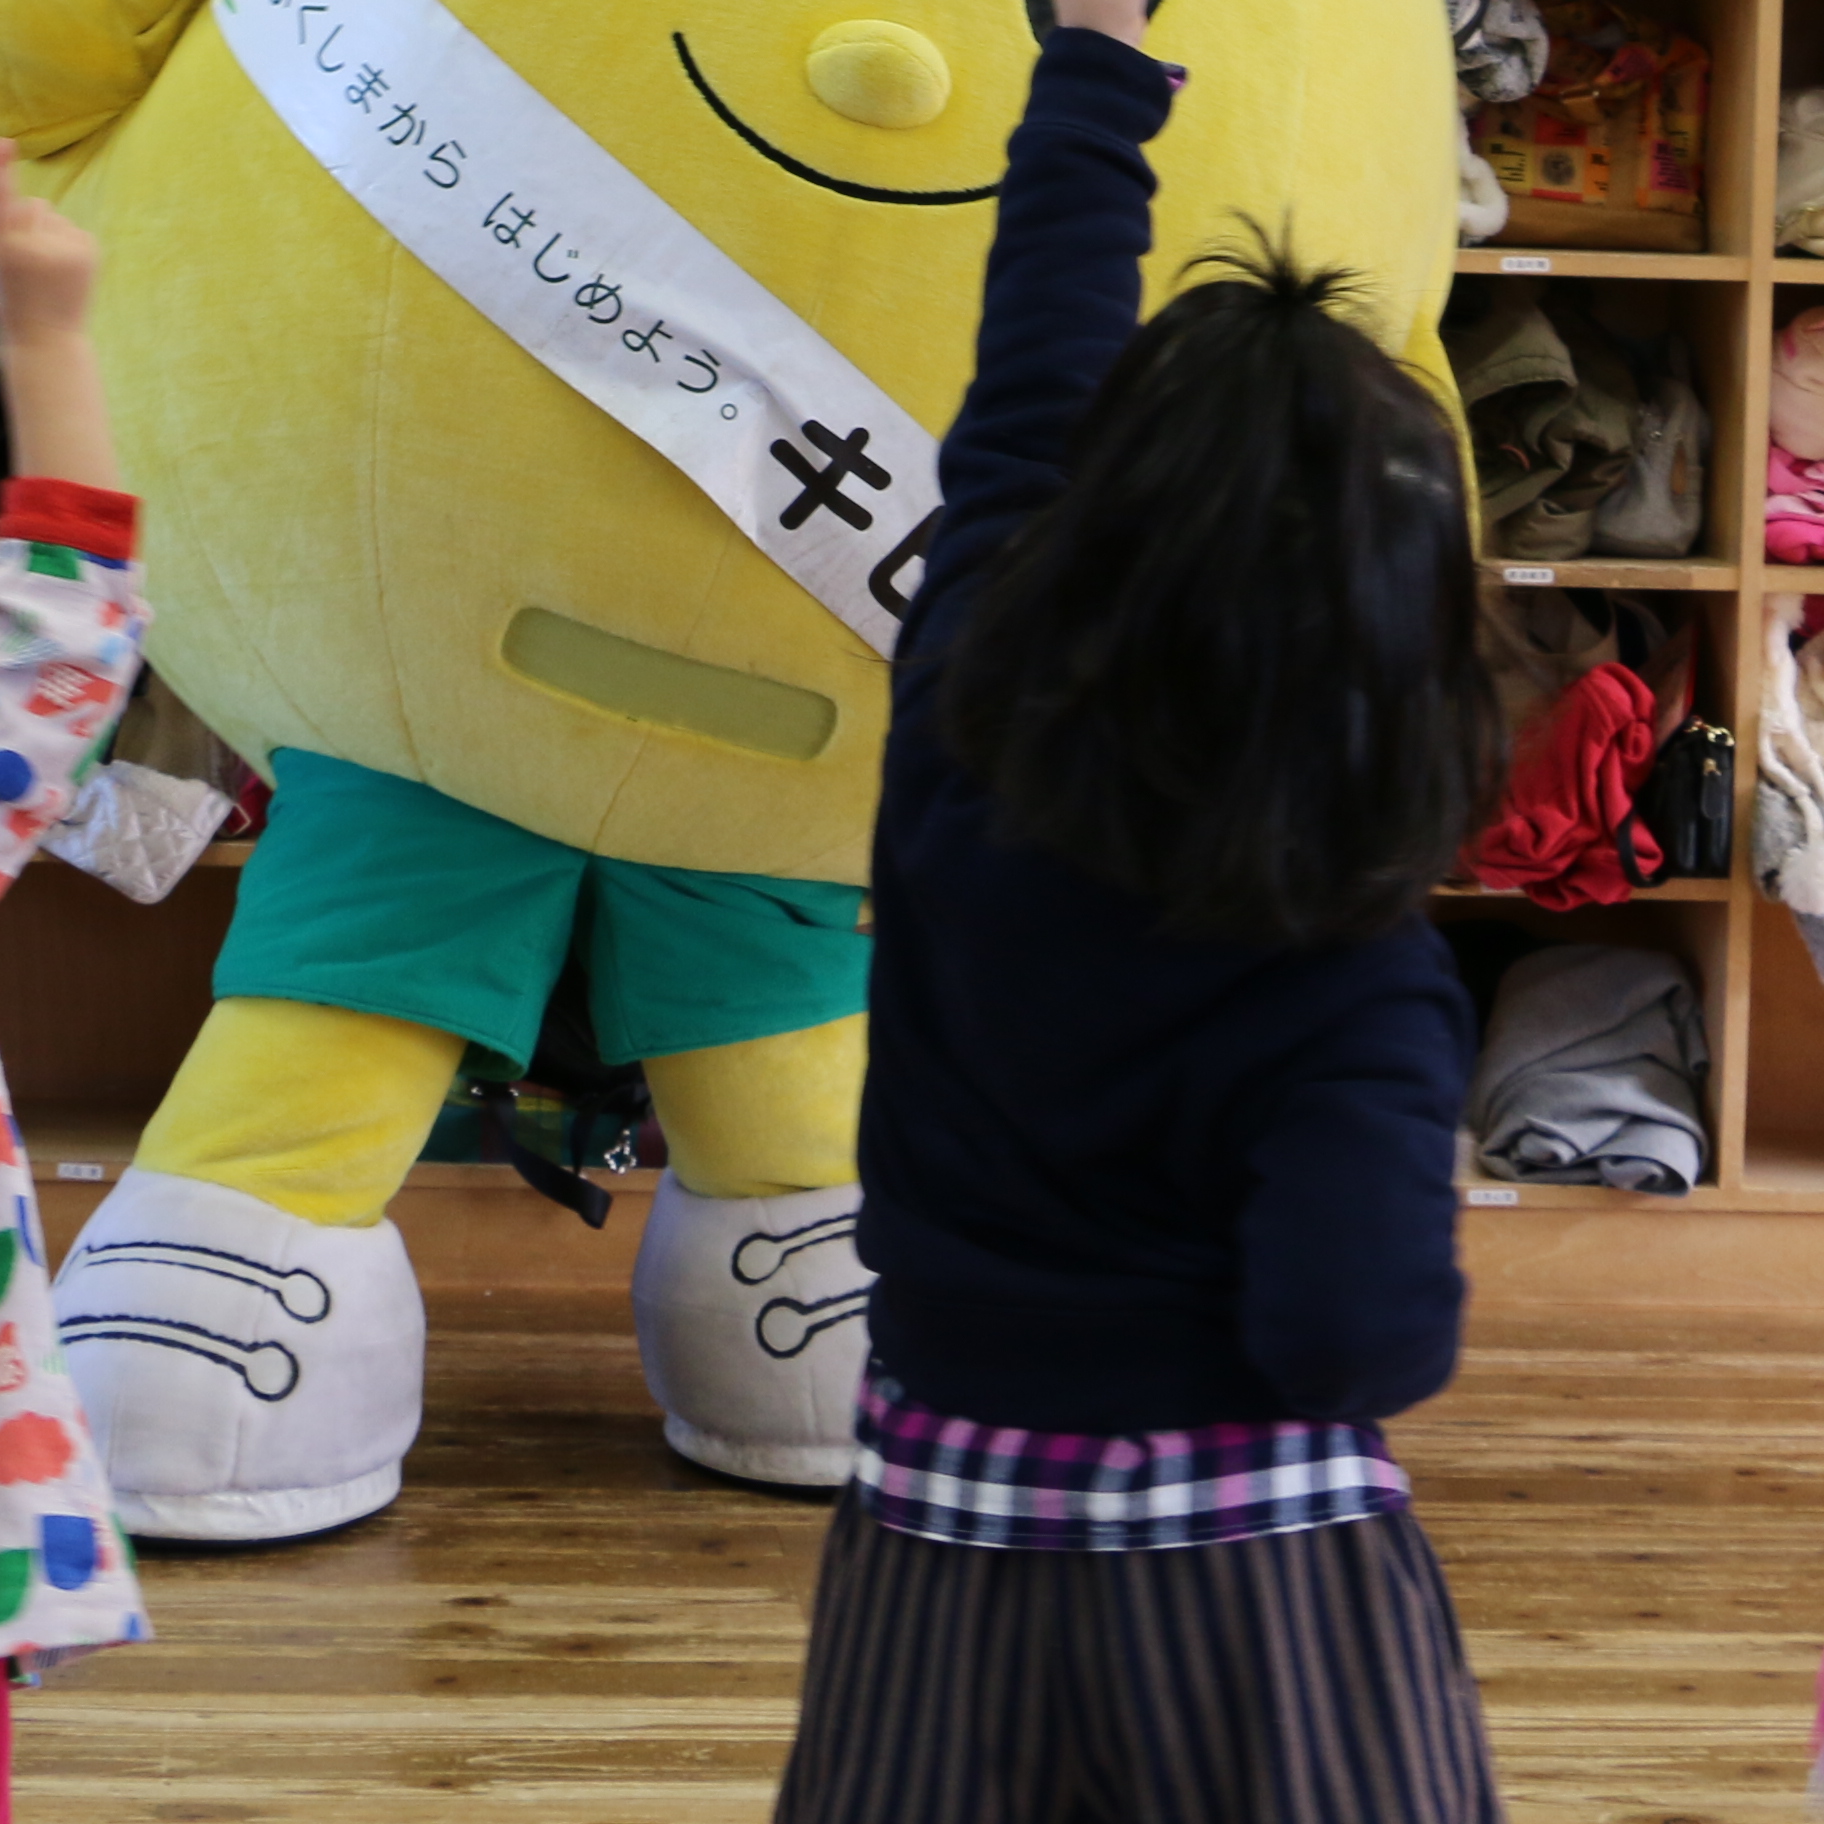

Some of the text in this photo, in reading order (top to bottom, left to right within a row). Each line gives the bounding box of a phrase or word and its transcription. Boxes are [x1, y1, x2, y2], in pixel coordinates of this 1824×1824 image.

[482, 192, 738, 421] はじめよう。
